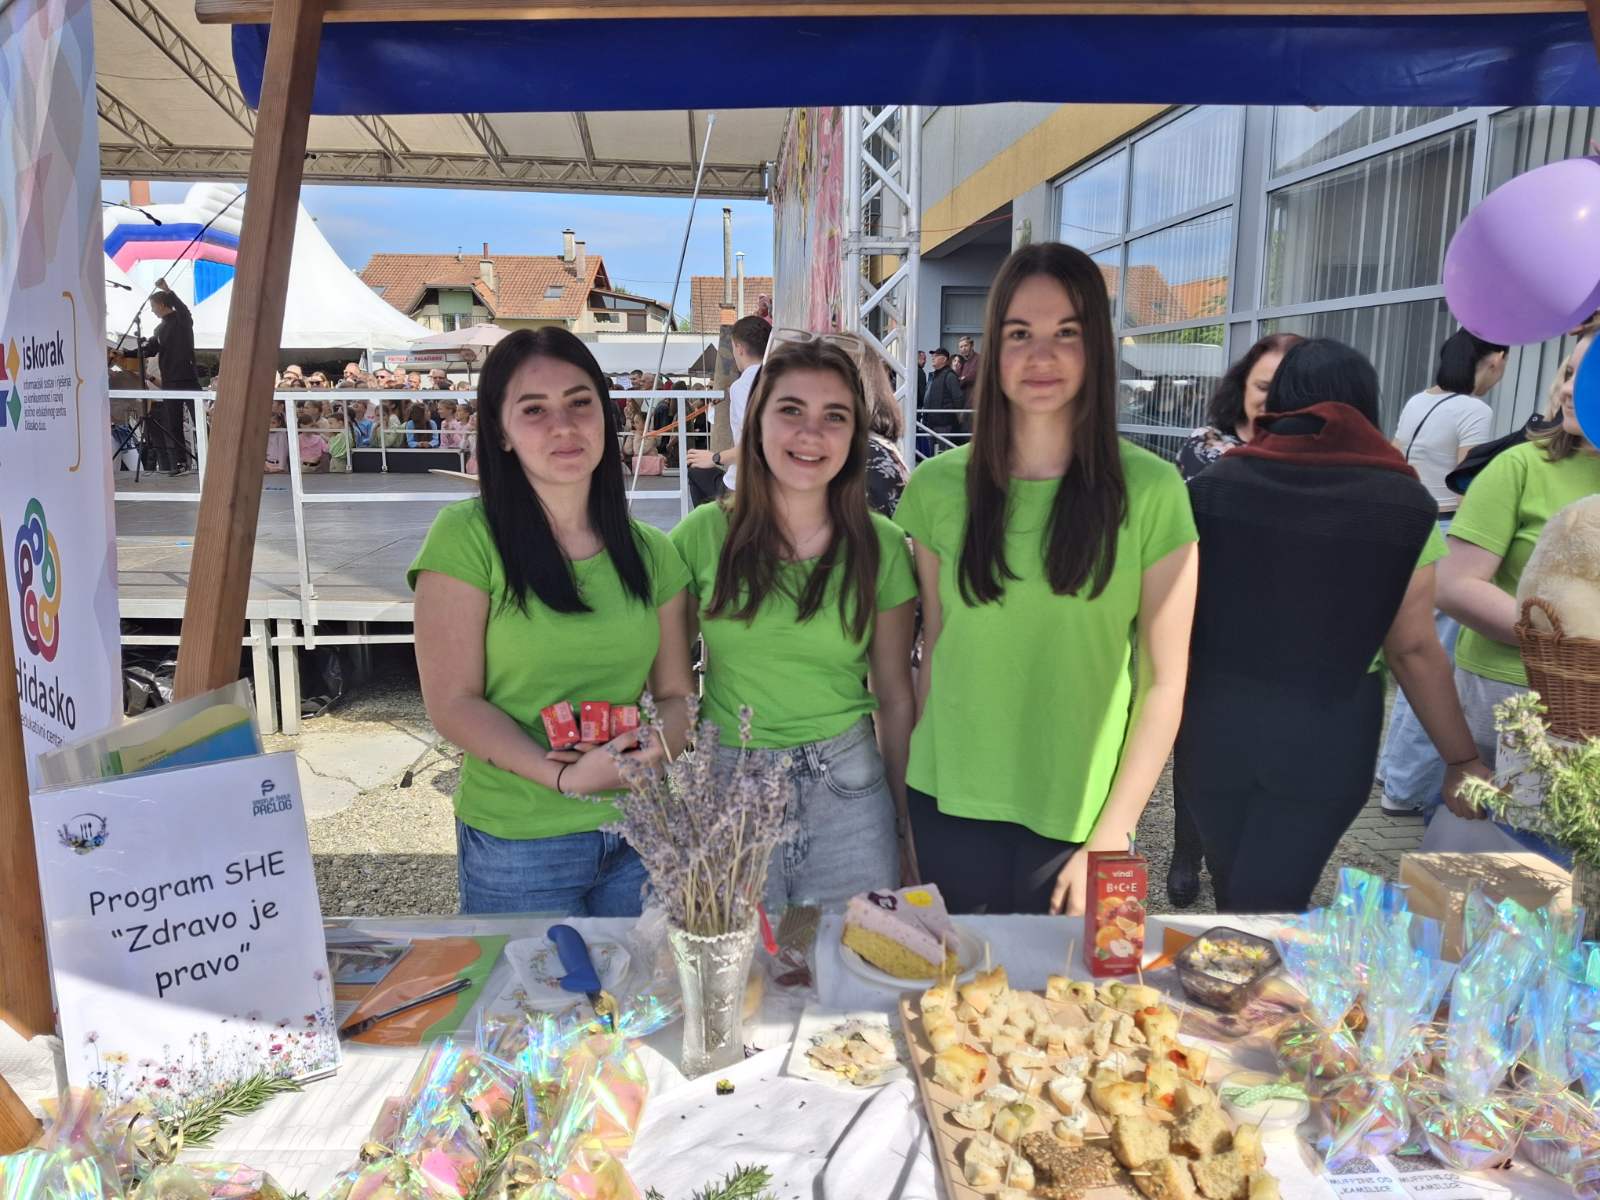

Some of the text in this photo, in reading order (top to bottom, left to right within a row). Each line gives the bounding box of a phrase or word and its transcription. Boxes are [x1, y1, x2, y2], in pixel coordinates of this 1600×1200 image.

[22, 330, 65, 371] iskorak
[252, 799, 293, 816] PRELOG
[89, 850, 286, 916] Program SHE
[1112, 870, 1134, 878] vindi
[249, 898, 279, 930] je
